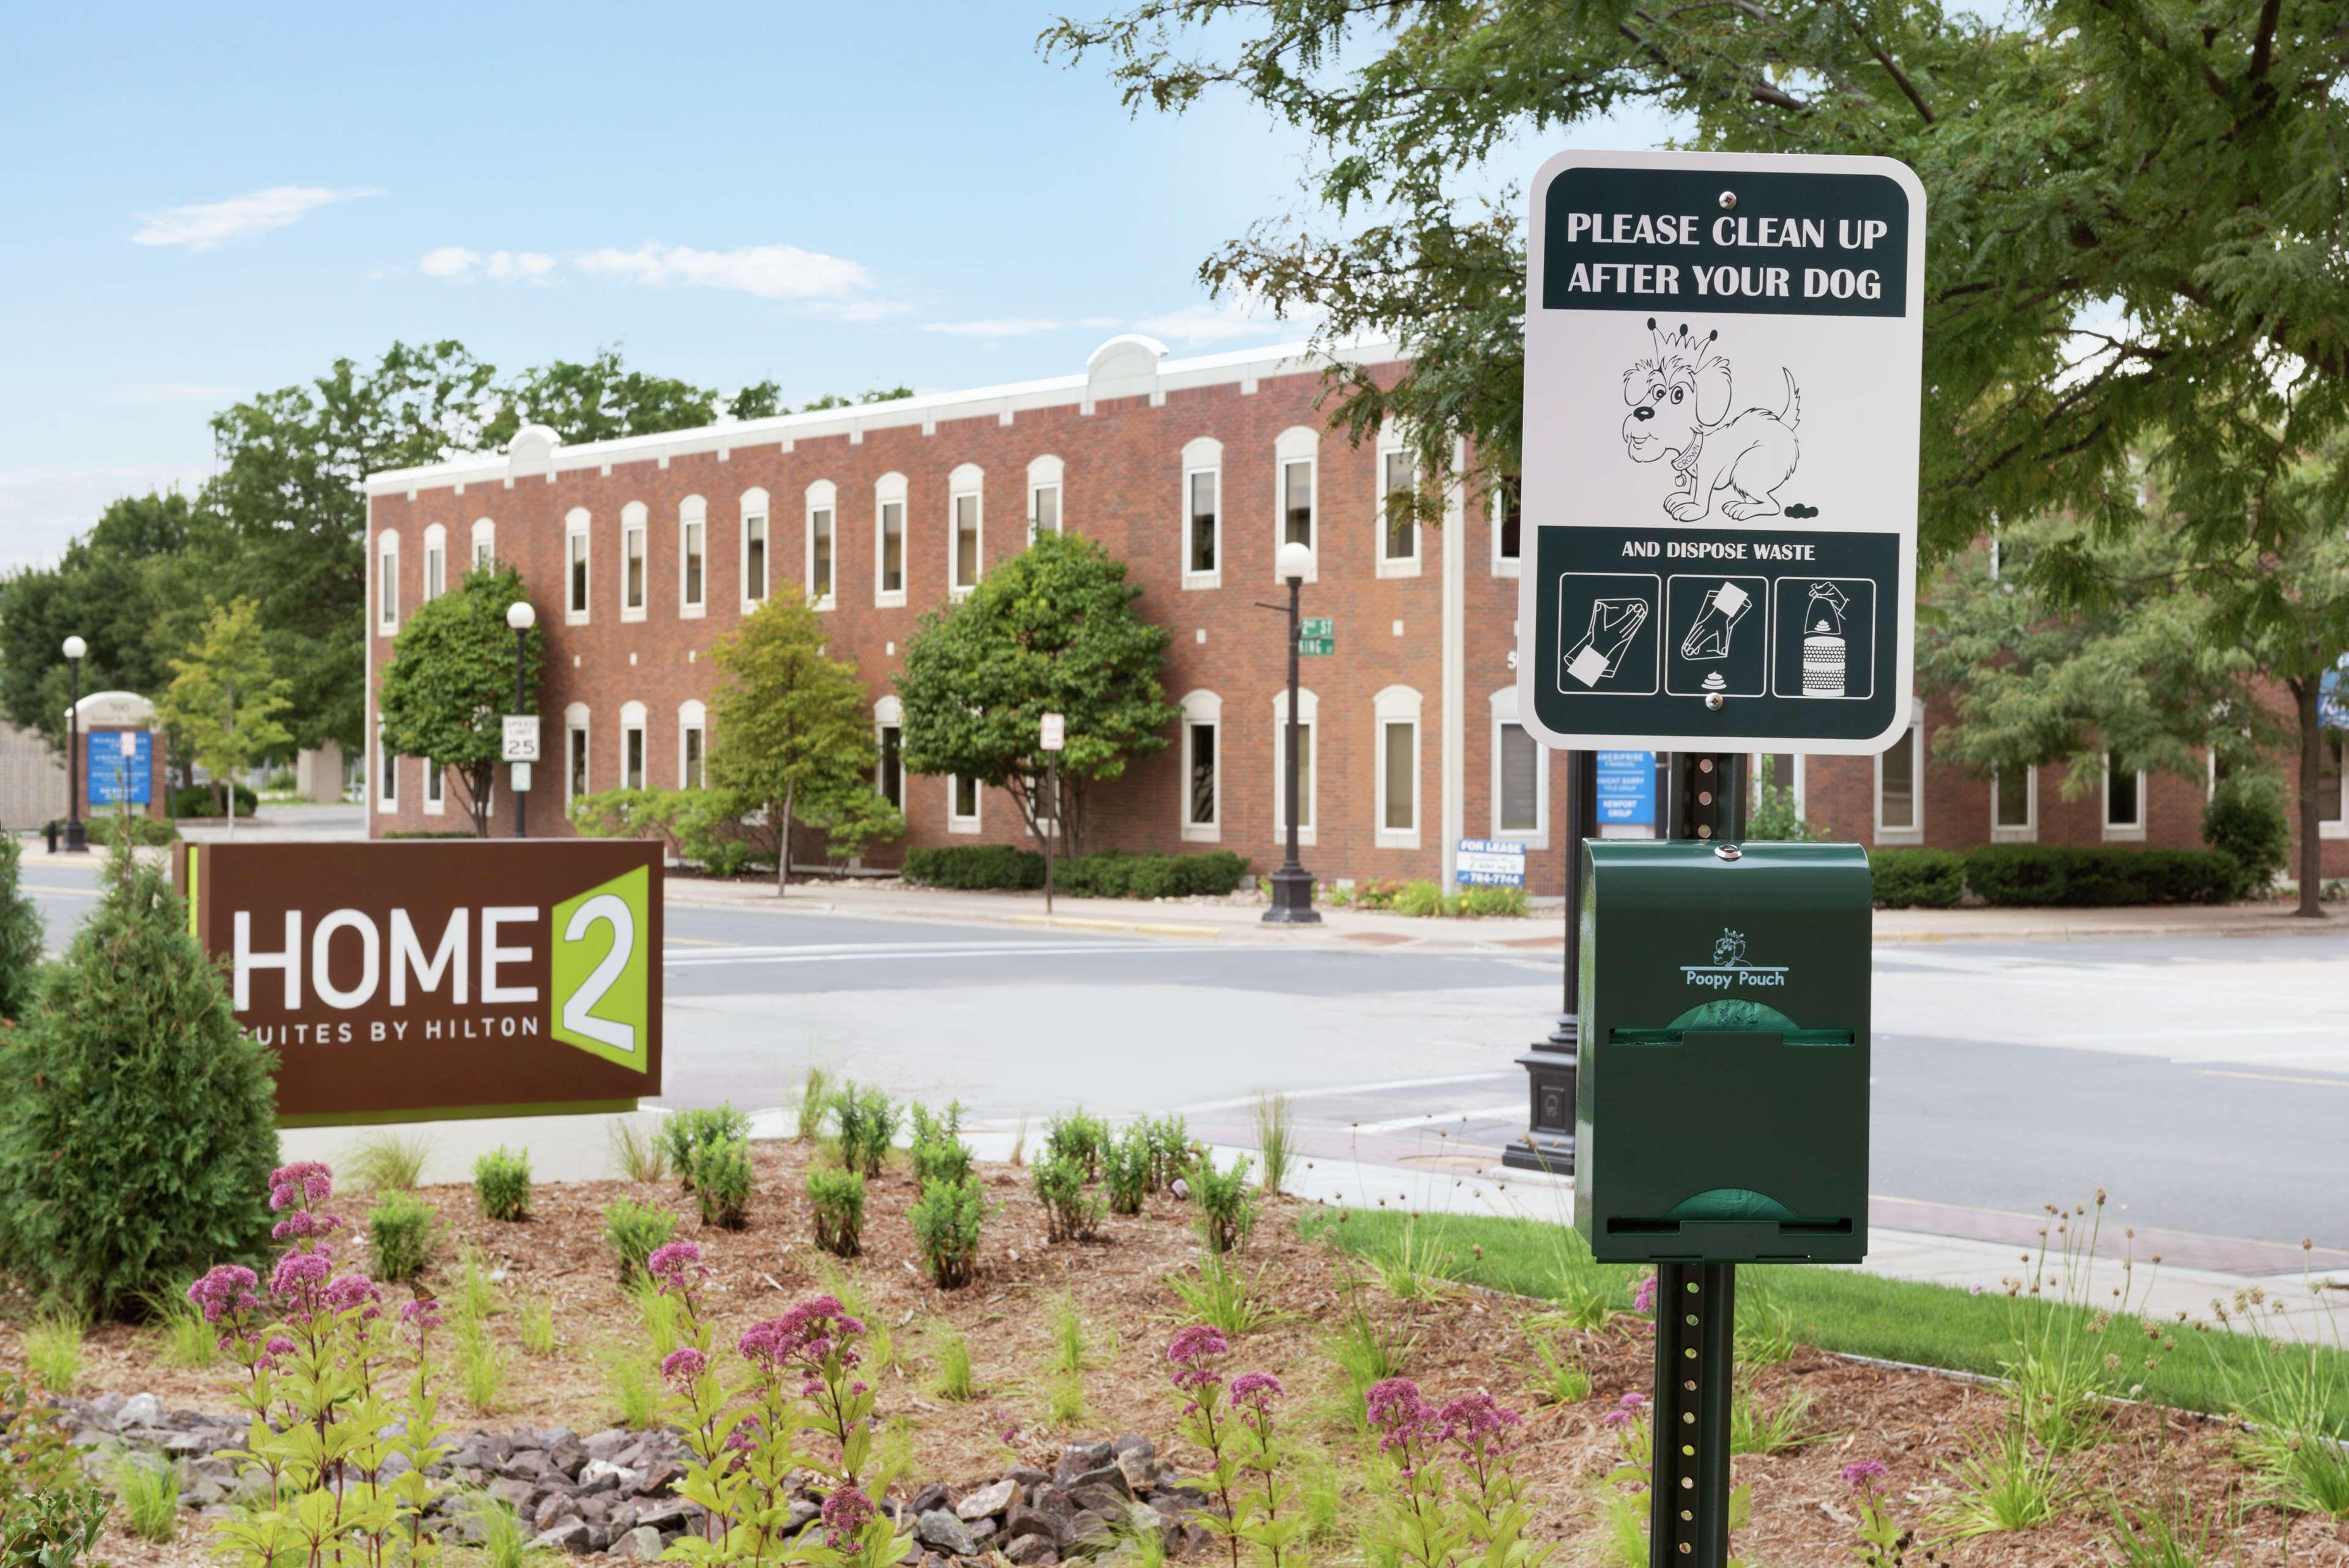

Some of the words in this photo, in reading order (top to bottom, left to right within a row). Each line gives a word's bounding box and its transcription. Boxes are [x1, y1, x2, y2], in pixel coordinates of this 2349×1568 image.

[1568, 213, 1700, 245] PLEASE
[1712, 216, 1825, 248] CLEAN
[1839, 219, 1888, 250] UP
[1568, 262, 1680, 294] AFTER
[1692, 266, 1790, 297] YOUR
[1804, 268, 1881, 299] DOG
[1677, 444, 1700, 469] CROWN
[1621, 541, 1661, 557] AND
[1667, 542, 1748, 559] DISPOSE
[1753, 543, 1815, 560] WASTE
[508, 740, 534, 754] 25
[1461, 841, 1484, 852] FOR
[1486, 842, 1521, 854] LEASE
[234, 906, 539, 1011] HOME
[564, 894, 635, 1052] 2
[1686, 971, 1733, 990] Poopy
[1739, 971, 1785, 986] Pouch
[371, 1021, 408, 1041] BY
[426, 1017, 538, 1039] HILTON
